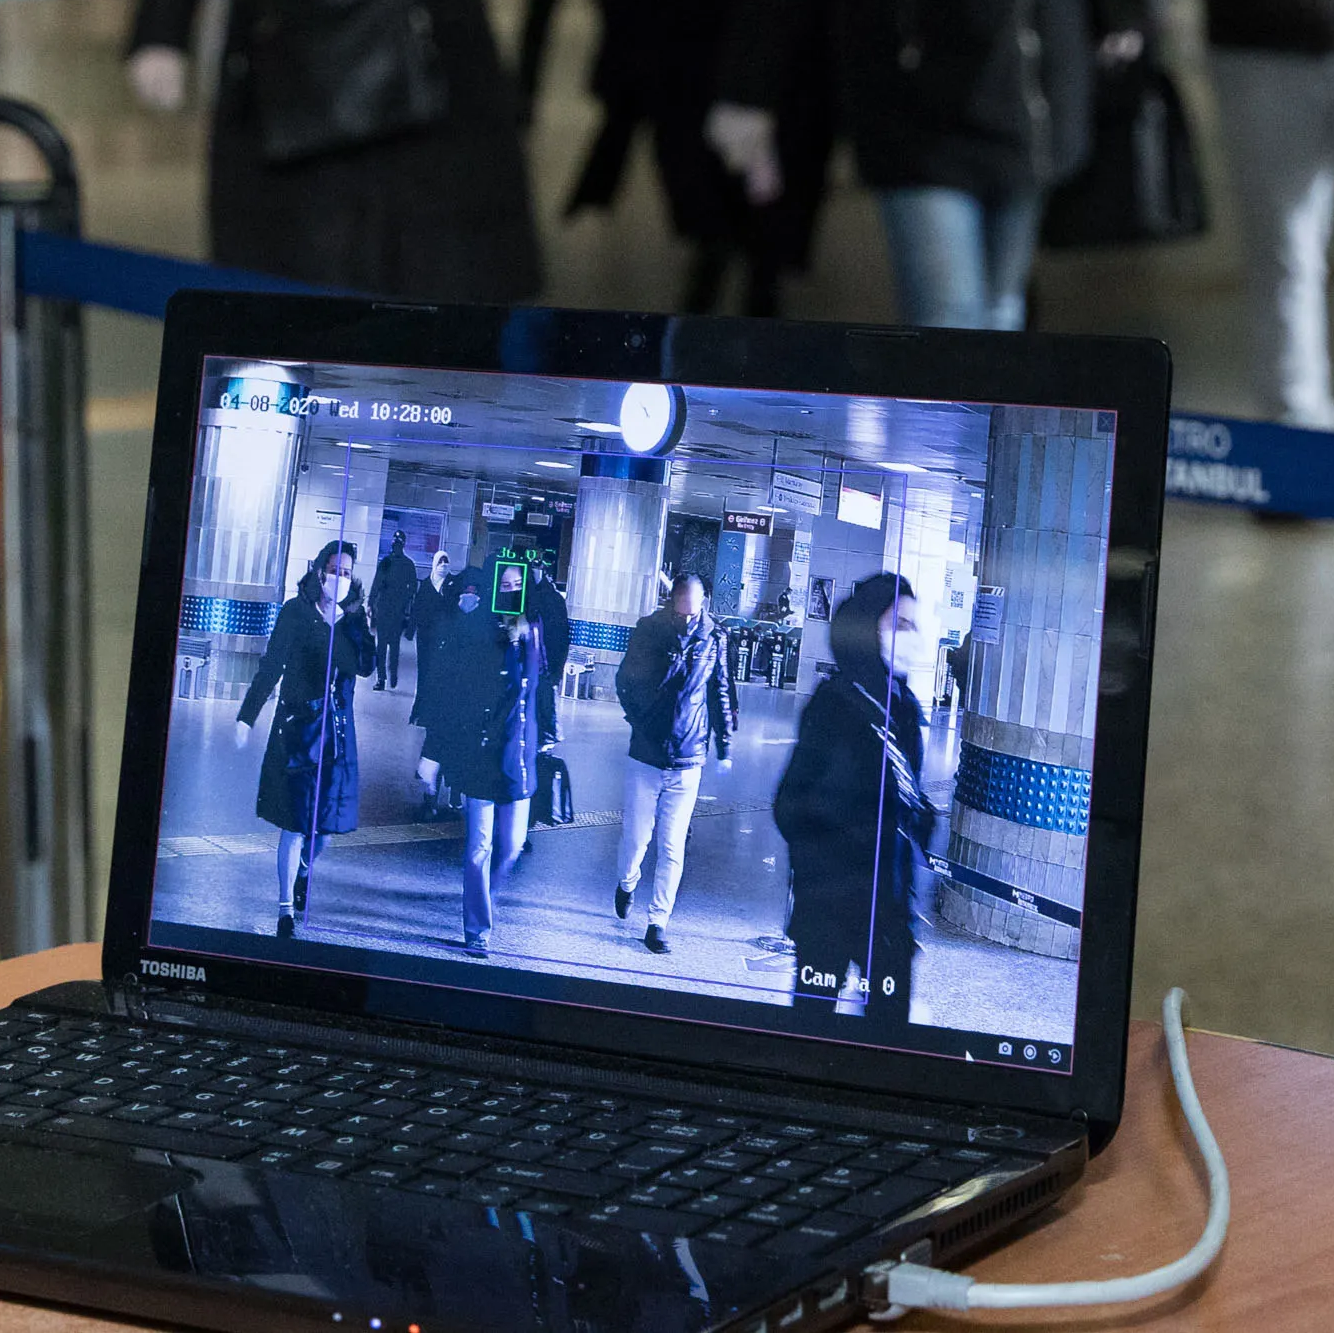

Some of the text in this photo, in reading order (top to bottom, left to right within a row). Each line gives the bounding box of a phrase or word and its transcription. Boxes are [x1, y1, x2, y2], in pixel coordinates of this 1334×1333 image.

[220, 392, 452, 424] 04-08-2020 Wed 10:28:00
[1169, 419, 1233, 461] TRO
[140, 959, 206, 982] TOSHIBA
[27, 1046, 47, 1054] Q
[75, 1053, 101, 1062] W
[122, 1060, 141, 1068] E
[45, 1070, 64, 1078] S
[171, 1067, 188, 1076] R
[94, 1077, 114, 1085] D
[224, 1075, 242, 1083] T
[274, 1082, 292, 1091] Y
[27, 1089, 49, 1097] X
[195, 1092, 215, 1101] G
[323, 1090, 344, 1098] U
[78, 1096, 98, 1104] C
[243, 1100, 267, 1109] H
[130, 1103, 150, 1112] V
[178, 1112, 196, 1120] B
[229, 1118, 252, 1128] N
[281, 1127, 307, 1137] M
